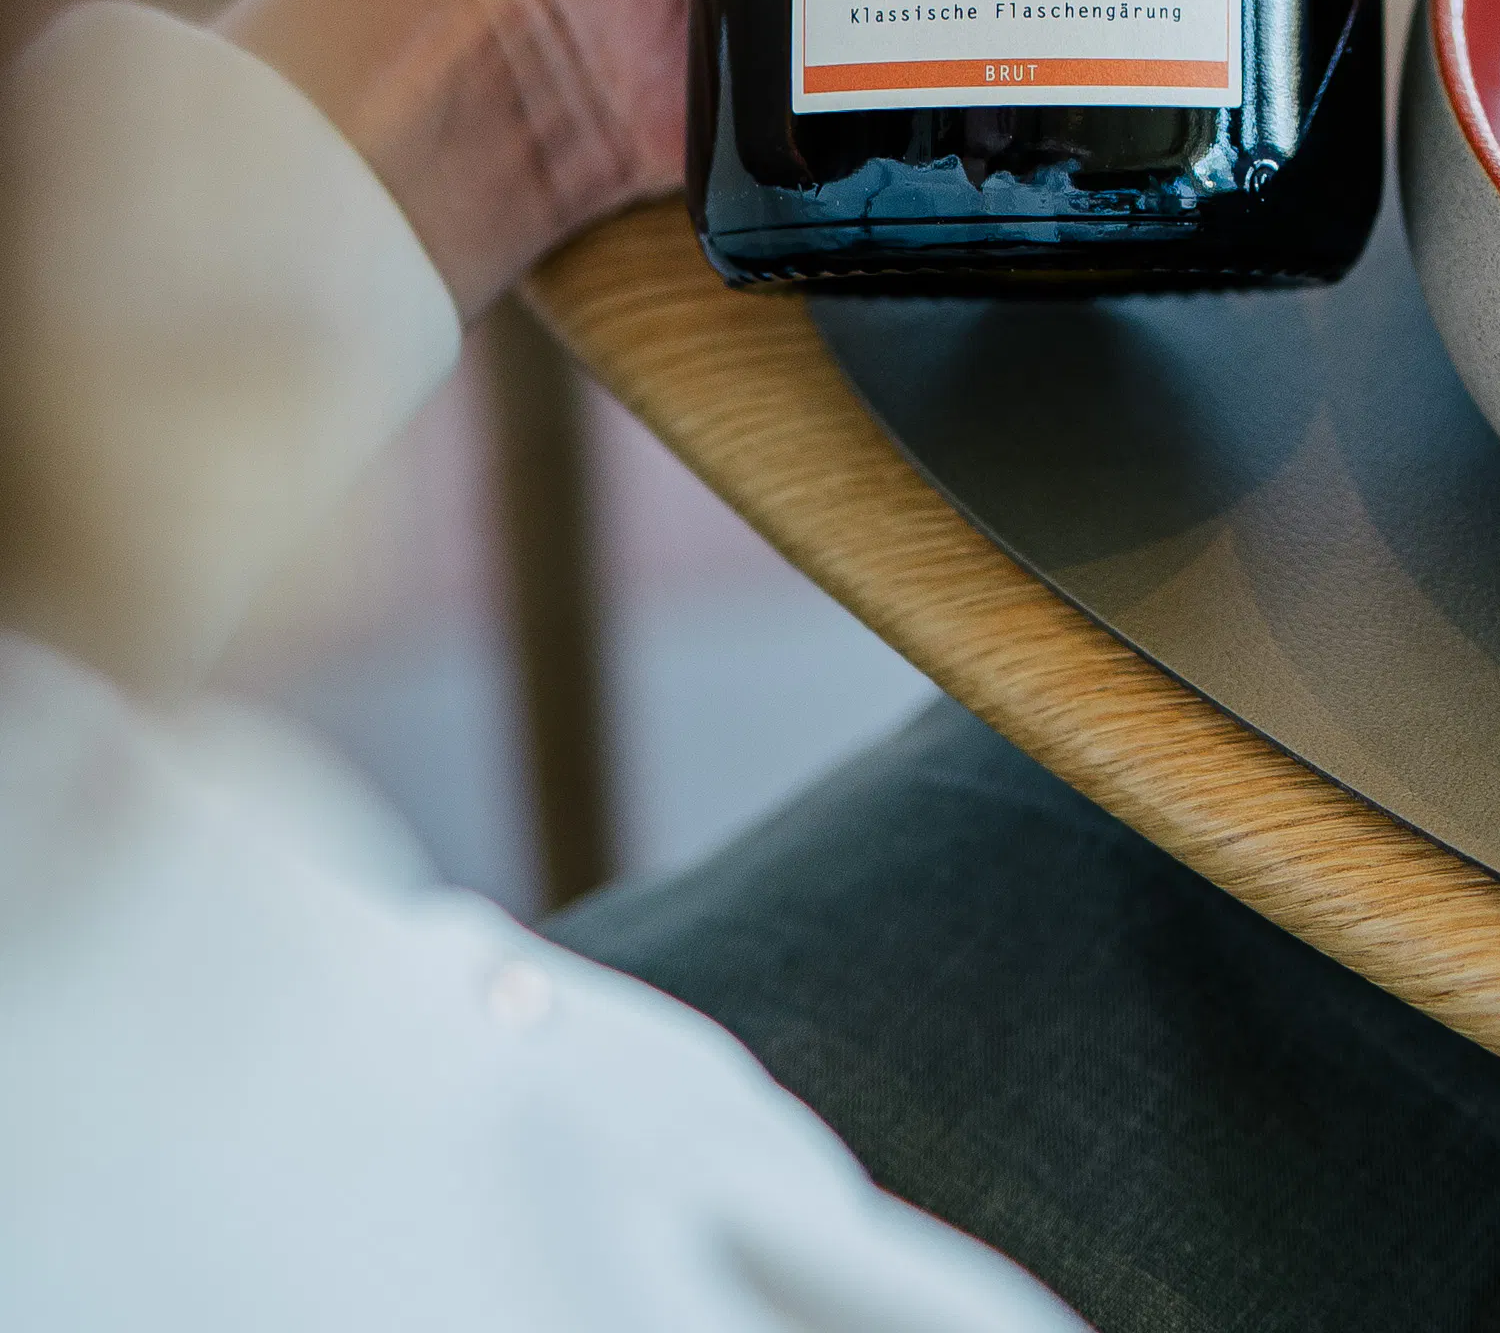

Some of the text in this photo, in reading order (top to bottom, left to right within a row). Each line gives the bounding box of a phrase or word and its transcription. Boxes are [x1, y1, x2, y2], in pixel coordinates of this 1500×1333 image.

[850, 2, 1182, 24] Klassische Flaschengärung
[984, 63, 1039, 82] BRUT
